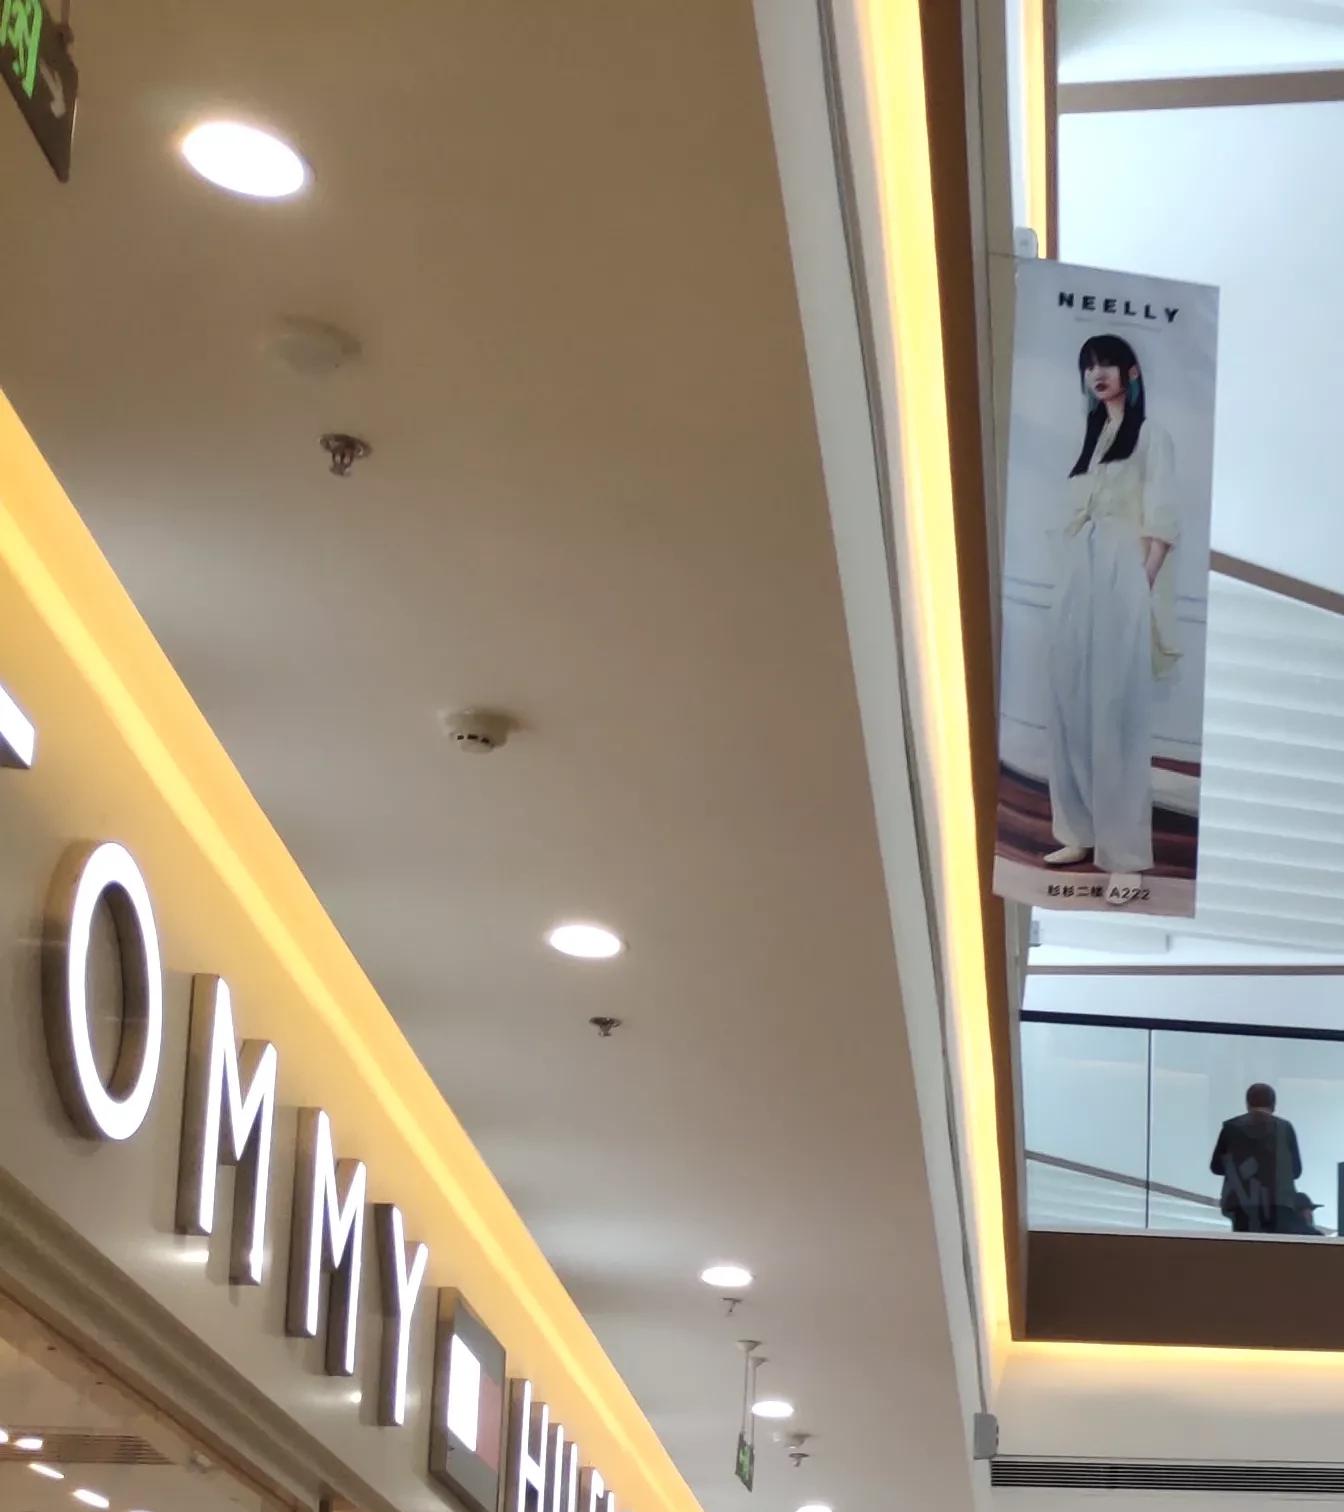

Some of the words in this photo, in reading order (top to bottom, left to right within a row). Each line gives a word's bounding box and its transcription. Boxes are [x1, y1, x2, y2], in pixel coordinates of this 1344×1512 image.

[1057, 291, 1179, 323] NEELLY
[1108, 887, 1151, 901] A222
[0, 684, 429, 1427] OMMY
